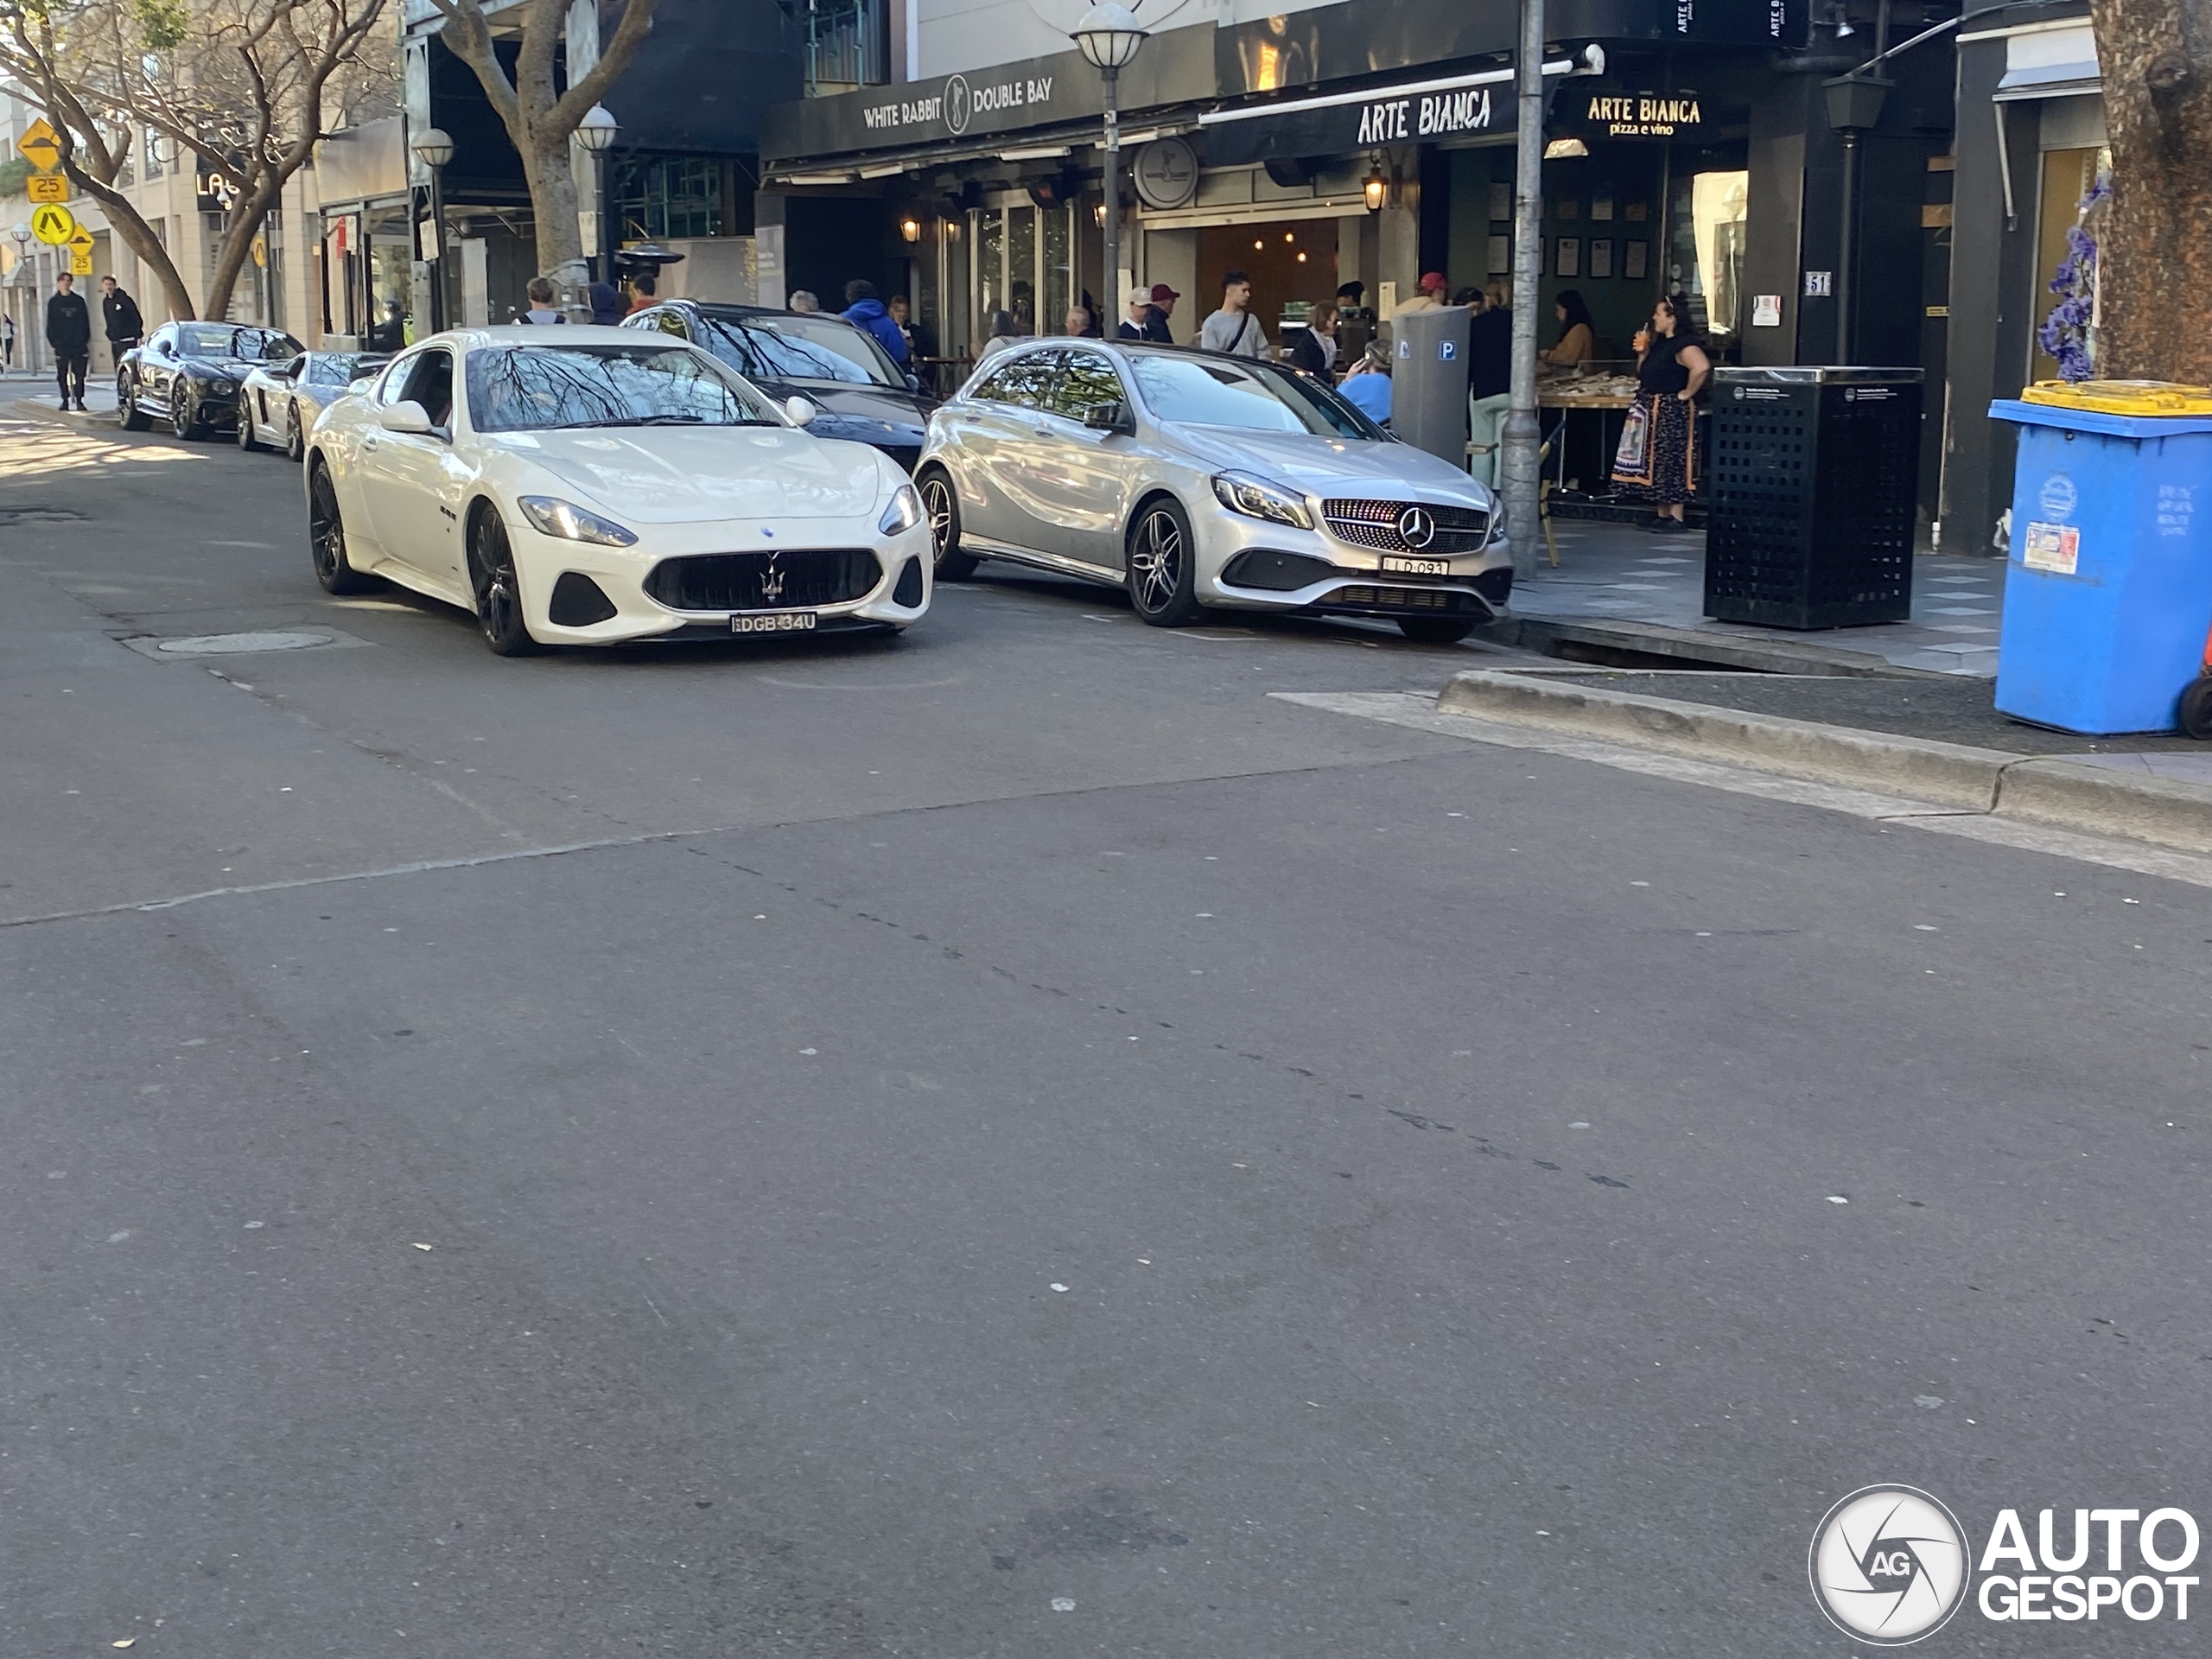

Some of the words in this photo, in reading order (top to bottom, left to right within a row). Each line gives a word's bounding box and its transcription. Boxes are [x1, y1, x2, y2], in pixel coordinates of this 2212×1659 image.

[1677, 6, 1688, 33] ARTE
[1770, 11, 1780, 36] ARTE
[863, 104, 899, 128] WHITE
[902, 97, 942, 124] RABBIT
[973, 83, 1022, 112] DOUBLE
[1027, 77, 1052, 104] BAY
[1588, 97, 1633, 120] ARTE
[1639, 99, 1700, 123] BIANCA
[1357, 100, 1409, 143] ARTE
[1419, 89, 1491, 135] BIANCA
[1610, 122, 1638, 137] pizza
[1641, 124, 1648, 134] e
[1650, 124, 1674, 135] vino
[36, 179, 60, 193] 25
[75, 258, 88, 269] 25
[1811, 276, 1825, 292] 51
[1443, 342, 1453, 358] P
